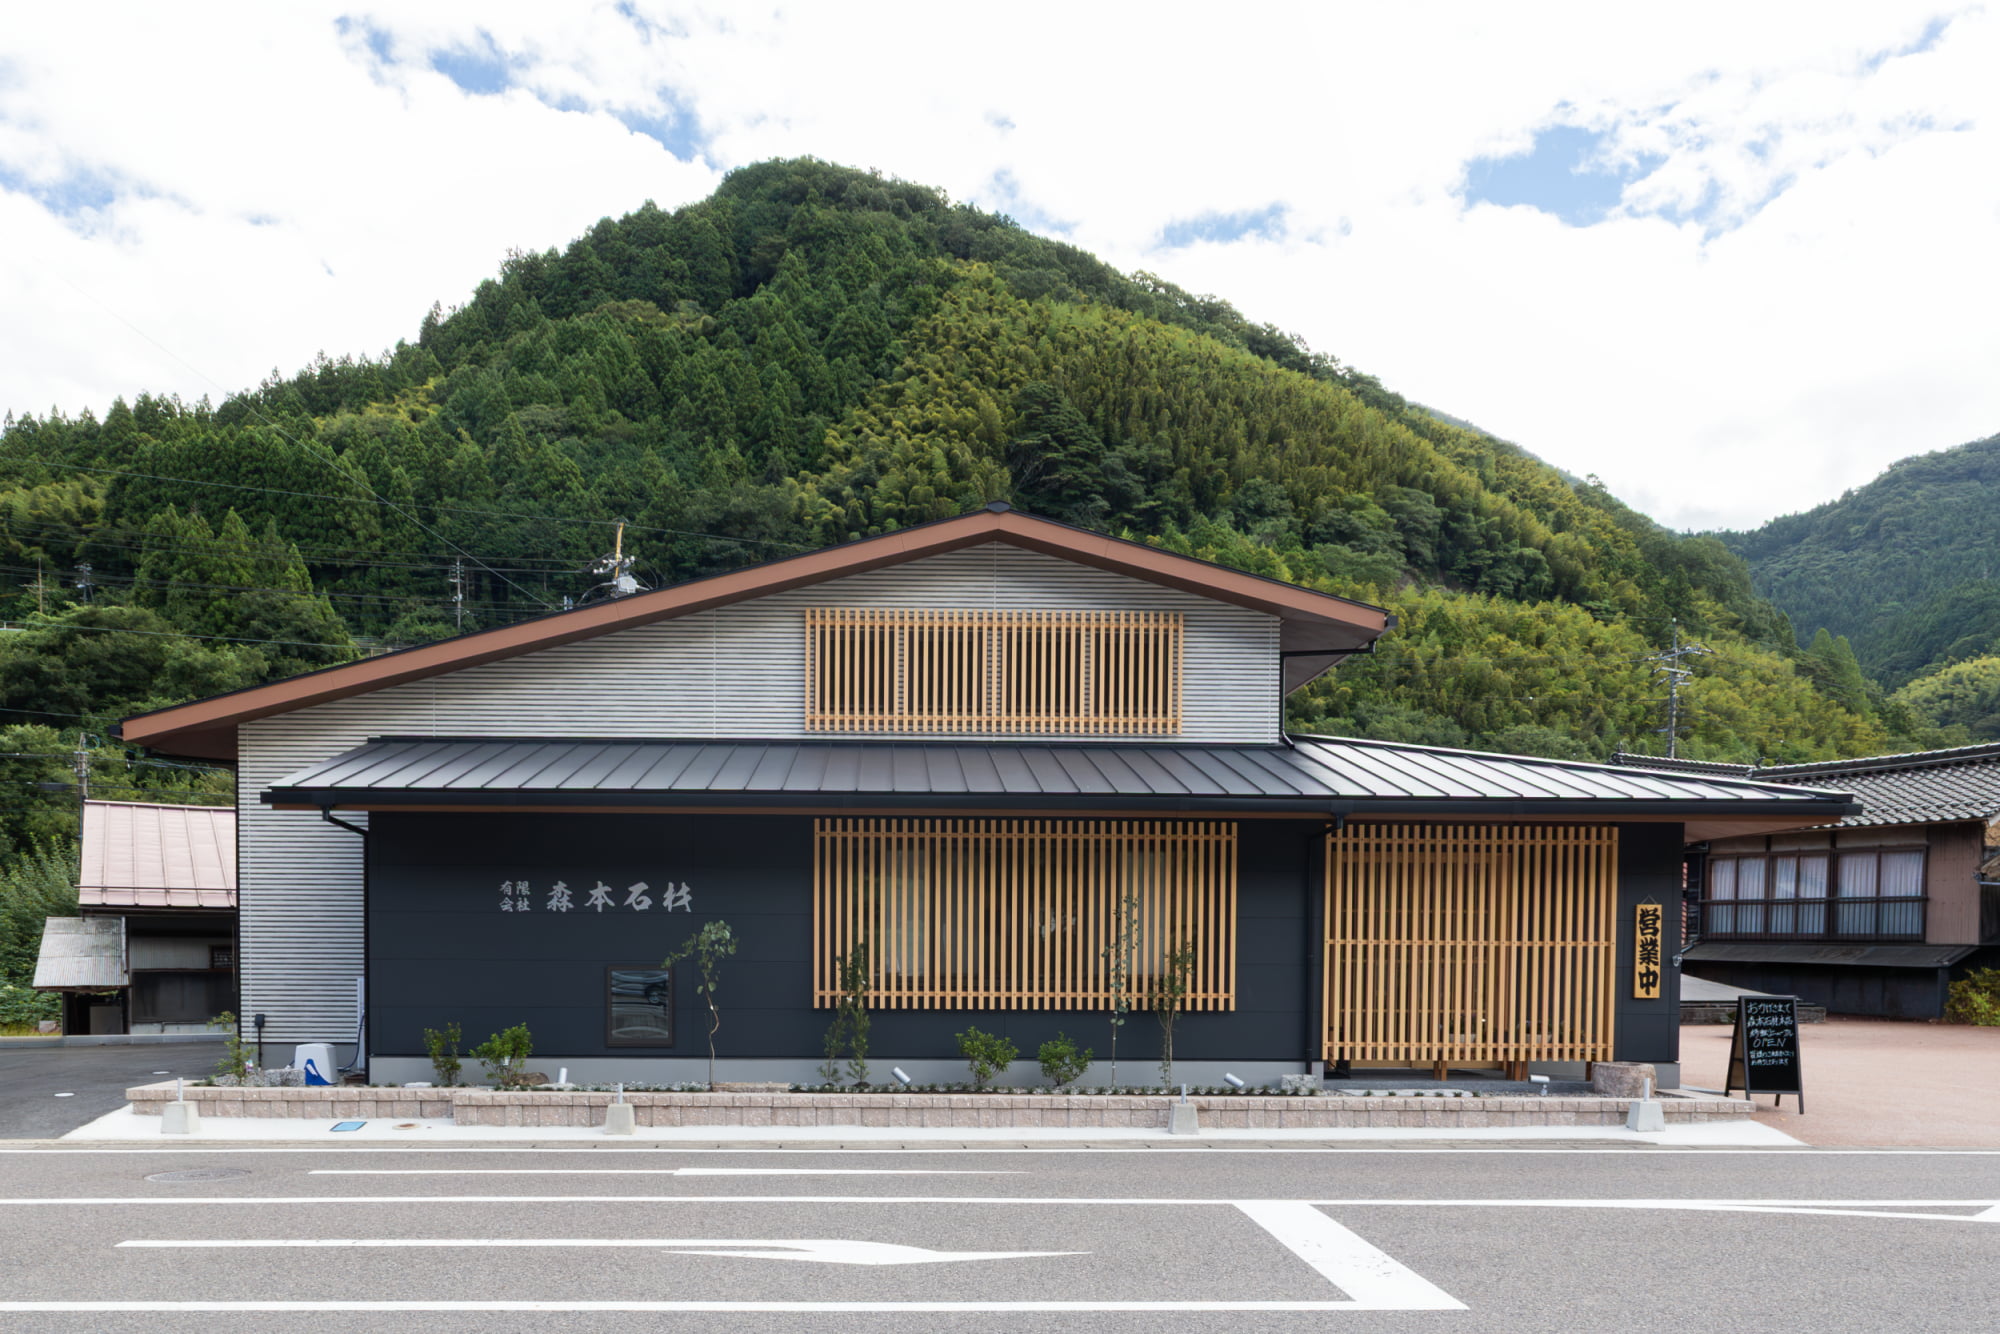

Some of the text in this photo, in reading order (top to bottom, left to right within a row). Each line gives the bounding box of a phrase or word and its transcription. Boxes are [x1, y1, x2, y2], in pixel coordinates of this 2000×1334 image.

[500, 880, 531, 896] 有限
[546, 880, 692, 912] 森本石材
[499, 897, 531, 912] 会社
[1638, 907, 1660, 996] 営業中
[1753, 1038, 1787, 1048] OPEN
